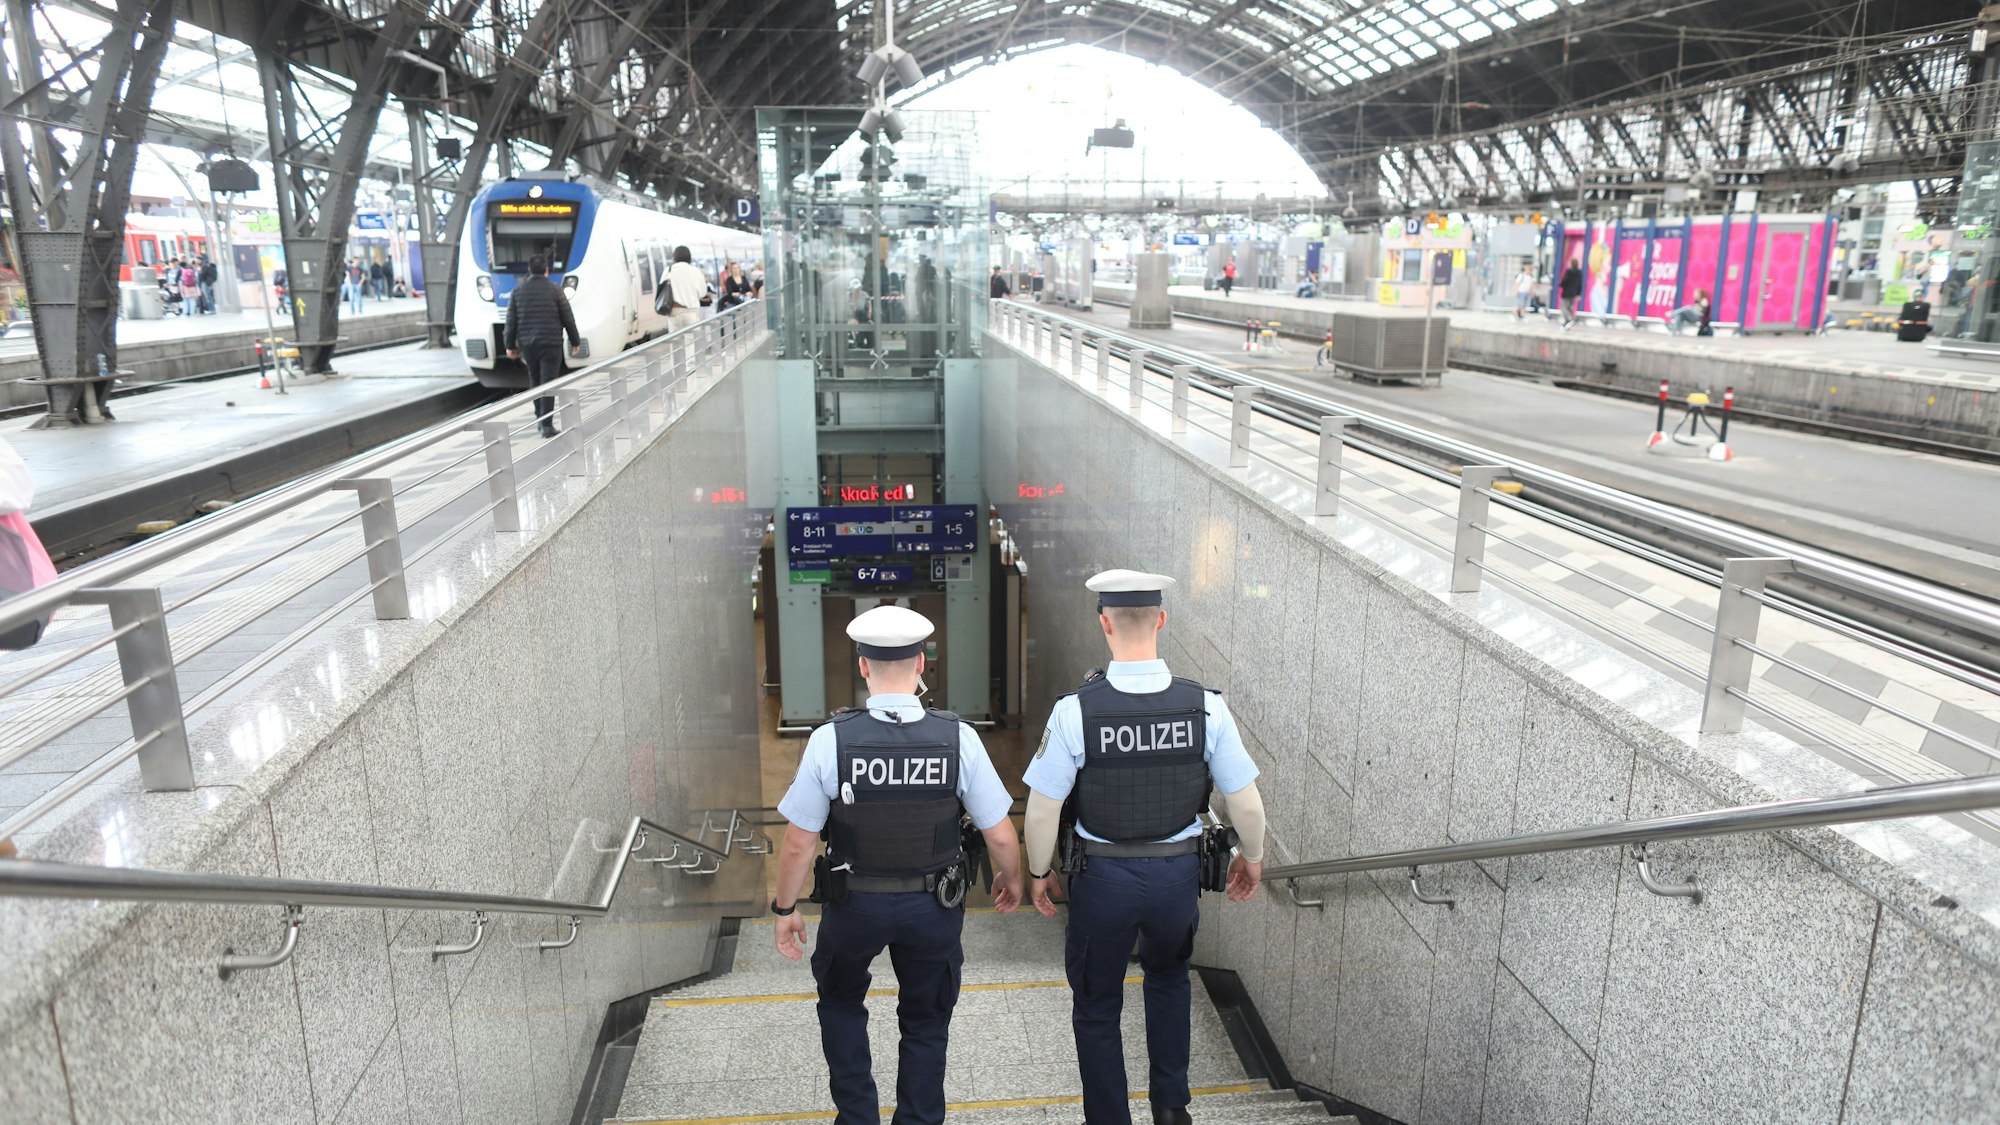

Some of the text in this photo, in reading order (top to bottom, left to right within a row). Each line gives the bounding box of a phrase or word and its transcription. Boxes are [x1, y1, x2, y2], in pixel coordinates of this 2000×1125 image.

[737, 198, 752, 217] D
[1407, 219, 1419, 233] D
[803, 526, 826, 538] 8-11
[944, 523, 963, 535] 1-5
[857, 567, 878, 580] 6-7
[1099, 720, 1194, 753] POLIZEI
[851, 757, 948, 786] POLIZEI
